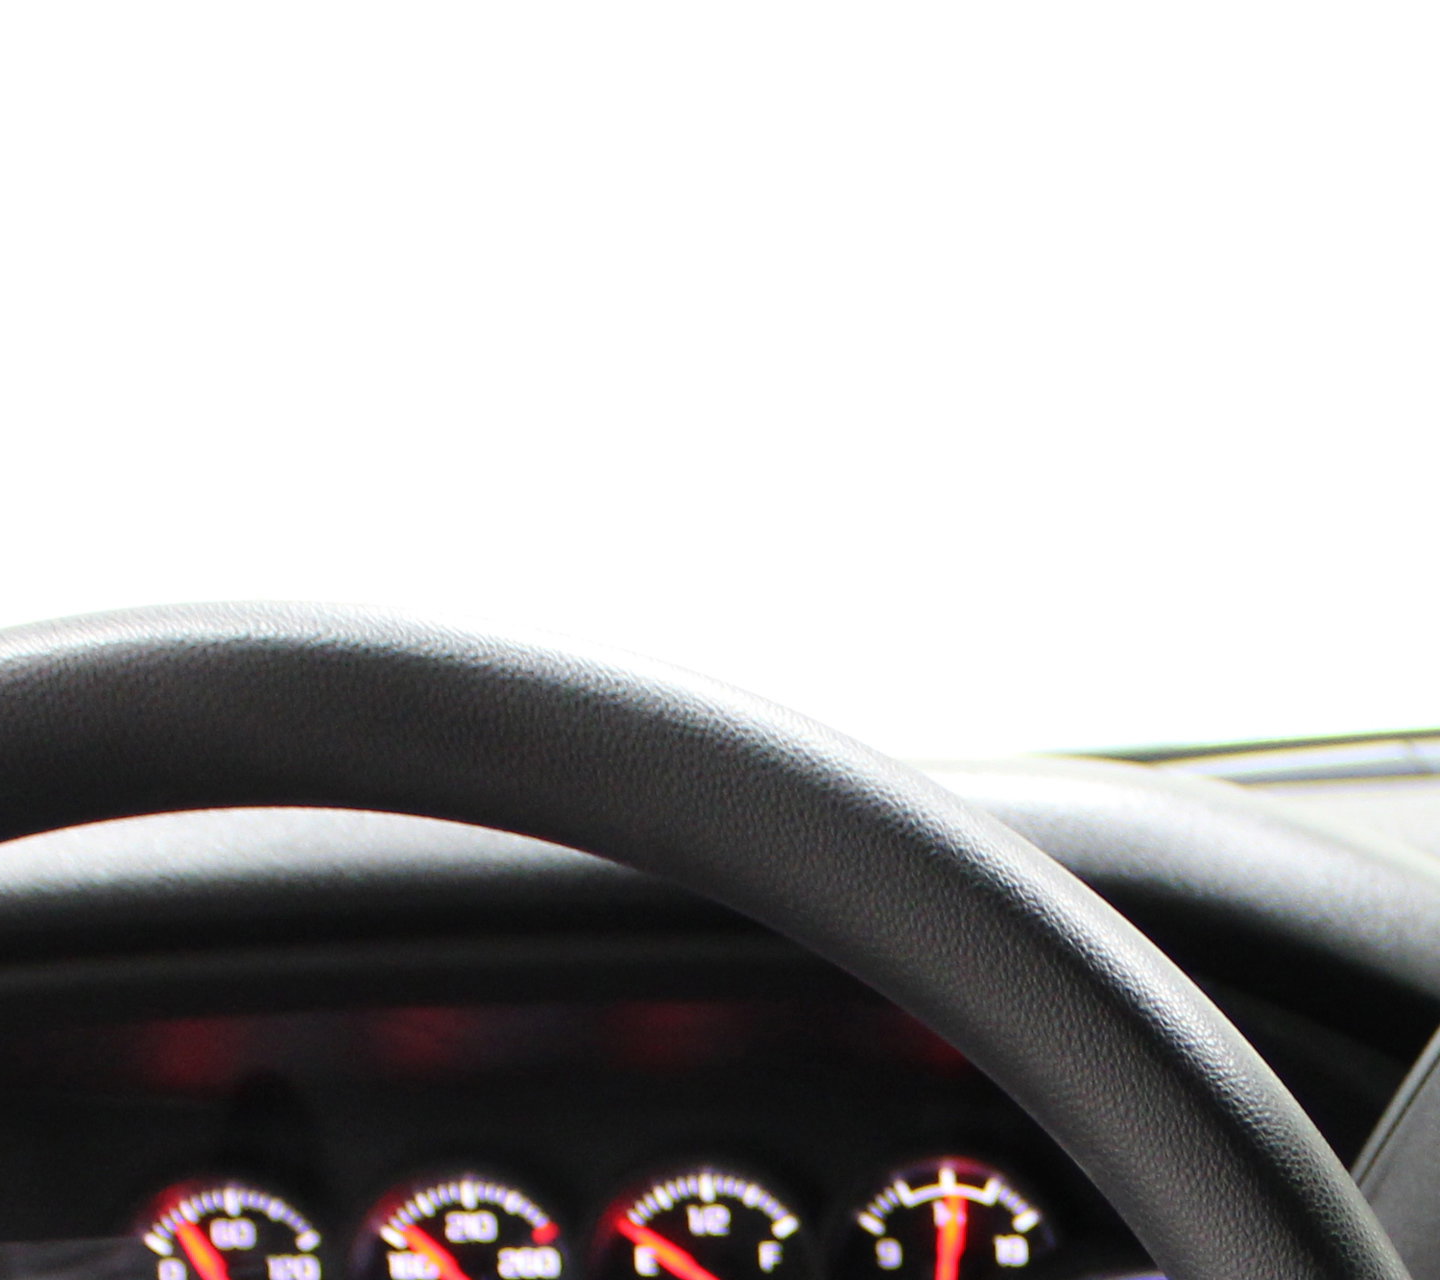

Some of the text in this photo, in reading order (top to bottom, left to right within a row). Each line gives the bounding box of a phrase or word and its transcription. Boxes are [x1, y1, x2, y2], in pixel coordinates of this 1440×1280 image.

[209, 1218, 257, 1251] 60
[445, 1209, 499, 1243] 210
[497, 1246, 562, 1280] 260
[758, 1240, 782, 1273] F
